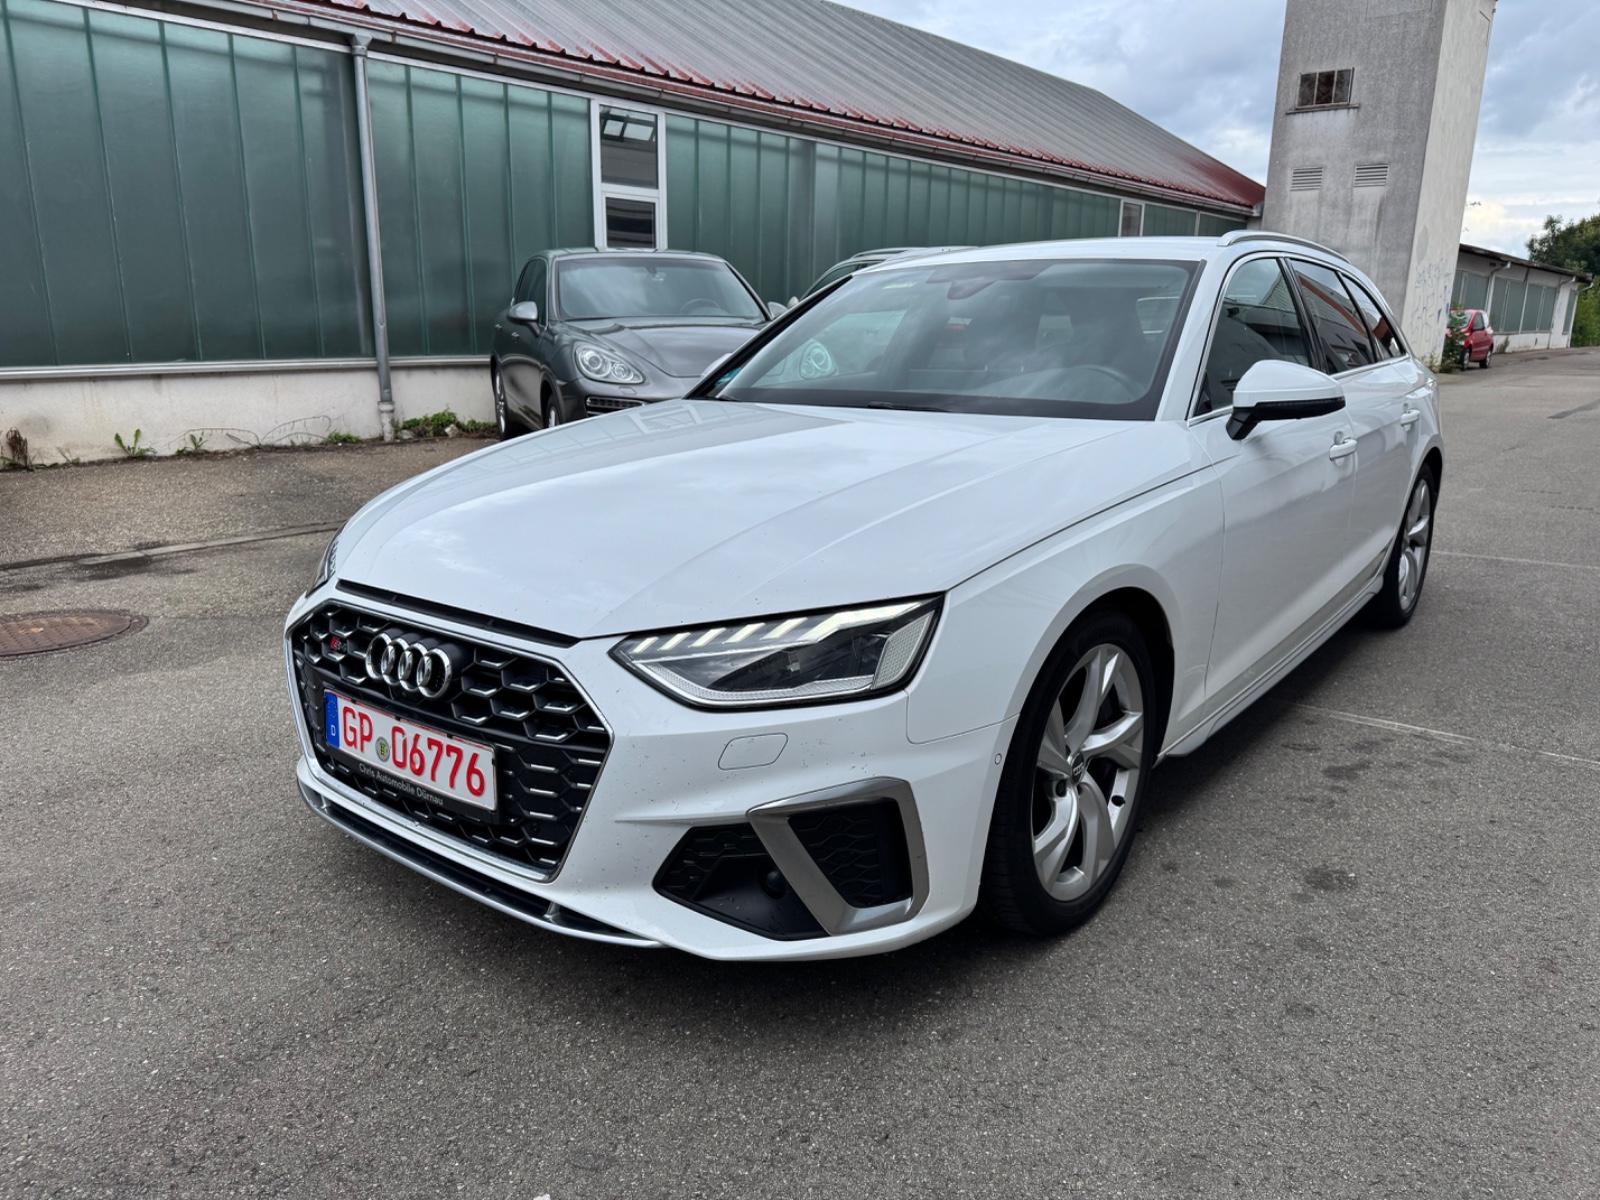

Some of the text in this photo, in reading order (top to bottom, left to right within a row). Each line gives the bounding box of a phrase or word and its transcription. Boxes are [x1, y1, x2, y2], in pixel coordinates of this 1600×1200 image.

[330, 724, 336, 737] D
[342, 706, 485, 797] GP 06776
[359, 762, 443, 805] Chris Automobile Dürnau
